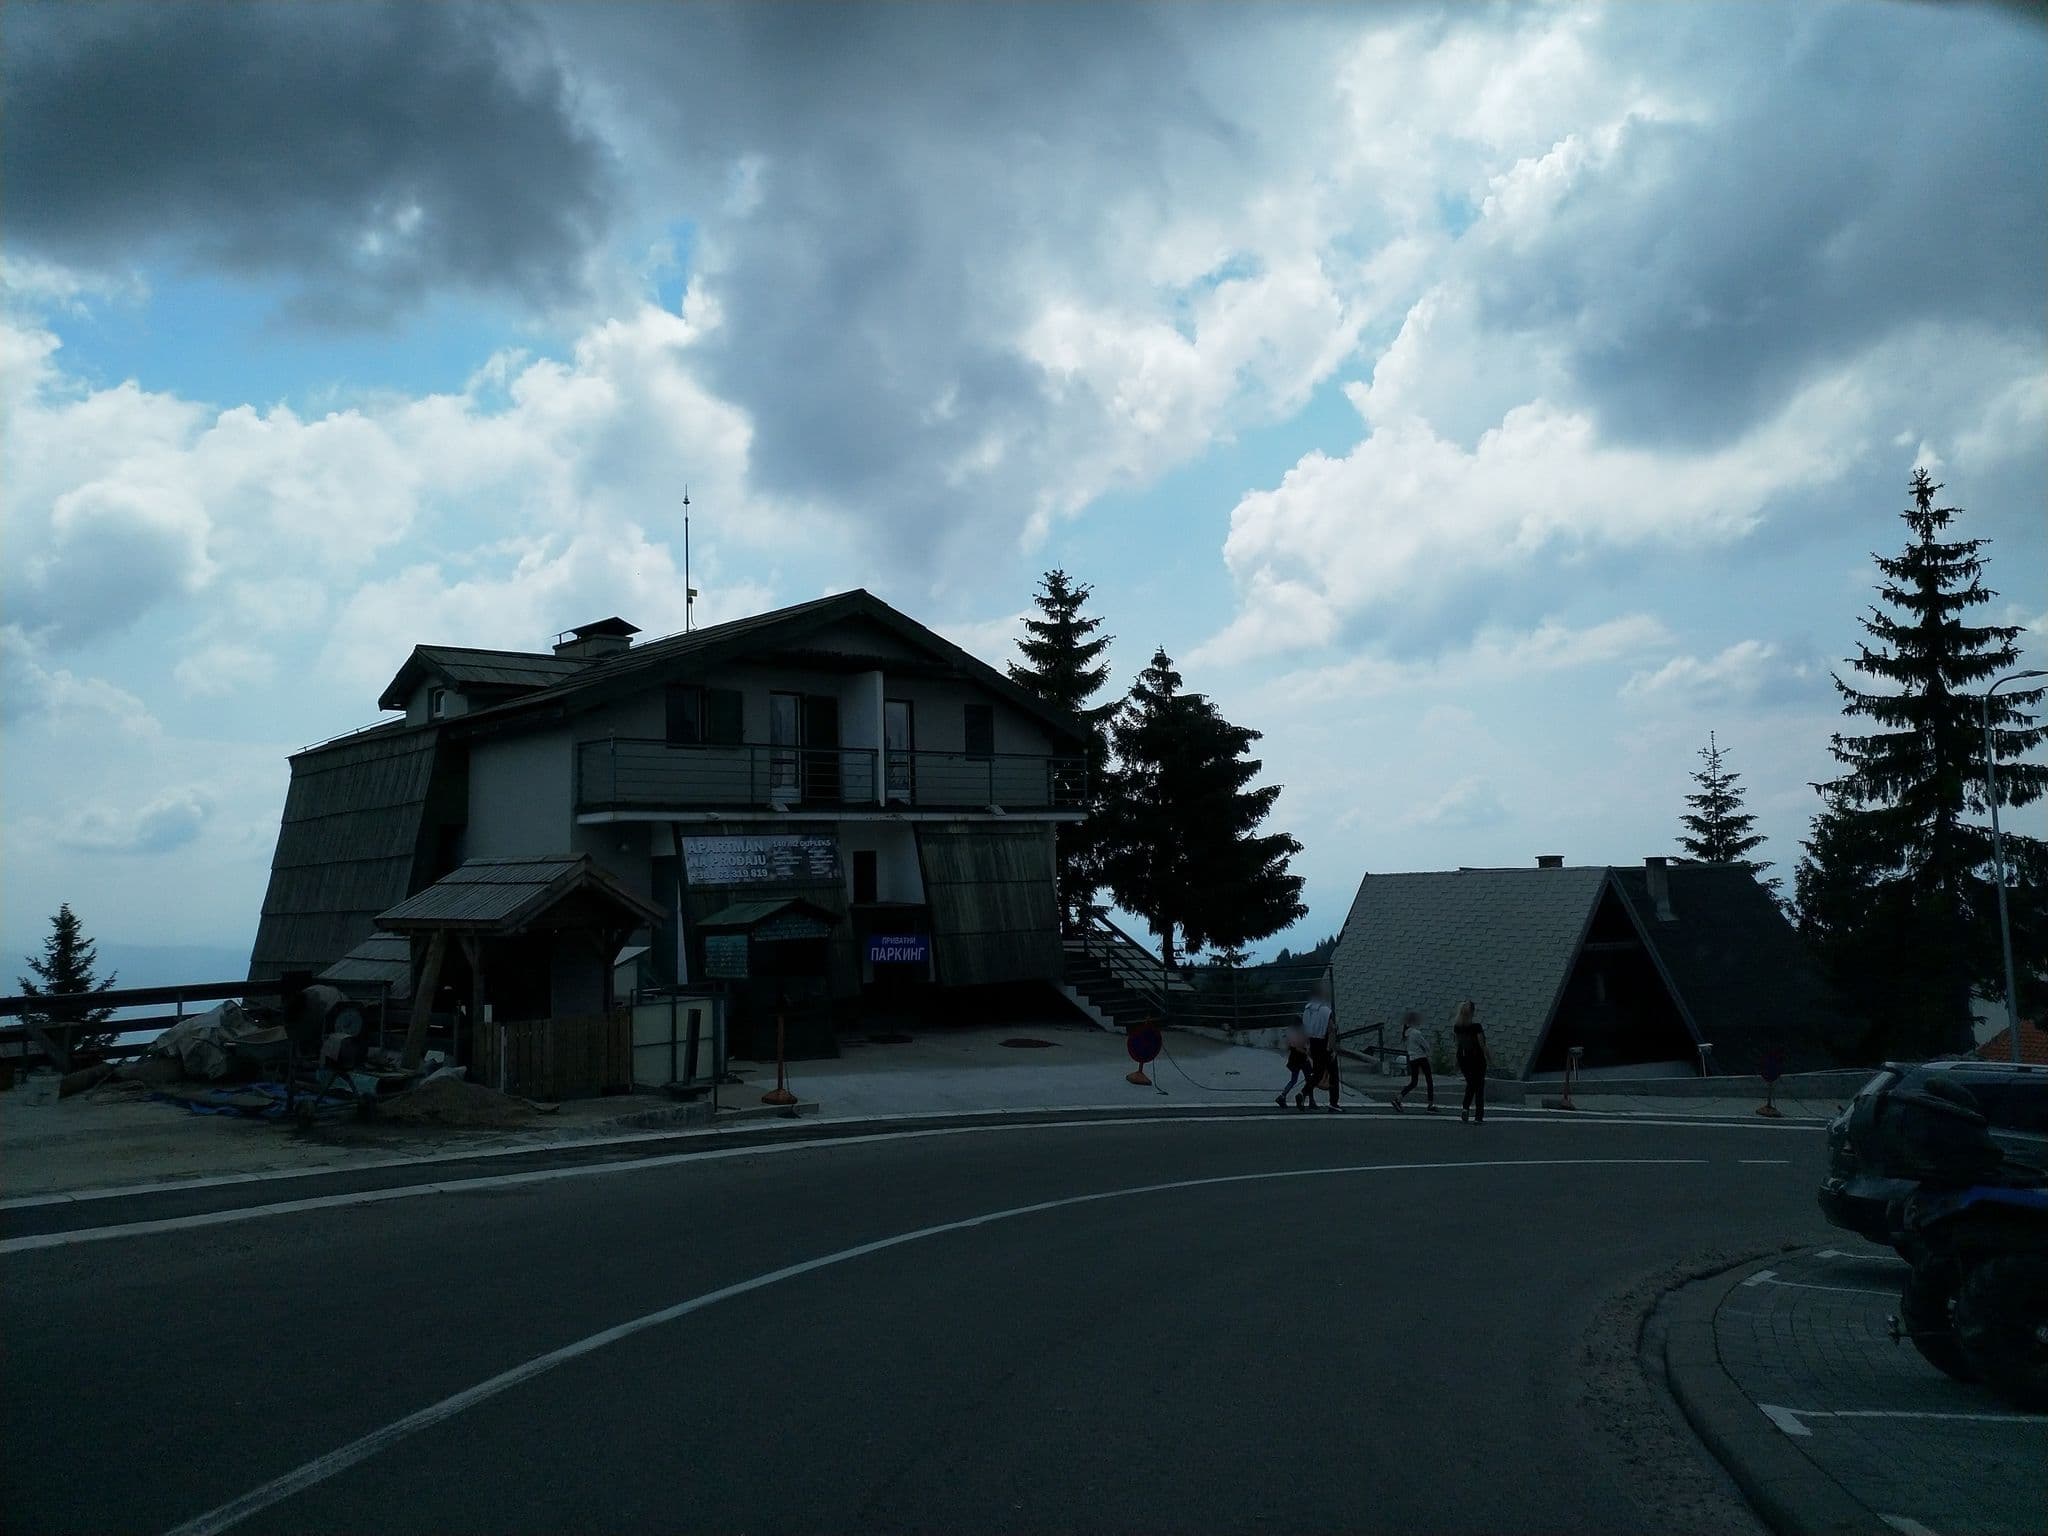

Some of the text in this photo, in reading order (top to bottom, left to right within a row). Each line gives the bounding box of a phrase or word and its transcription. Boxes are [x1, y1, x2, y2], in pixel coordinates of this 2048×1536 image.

[688, 840, 765, 855] APARTMAN
[711, 854, 767, 868] PRODAJU
[882, 936, 916, 945] ПРИВАТНИ
[871, 947, 925, 961] ПАРКИНГ
